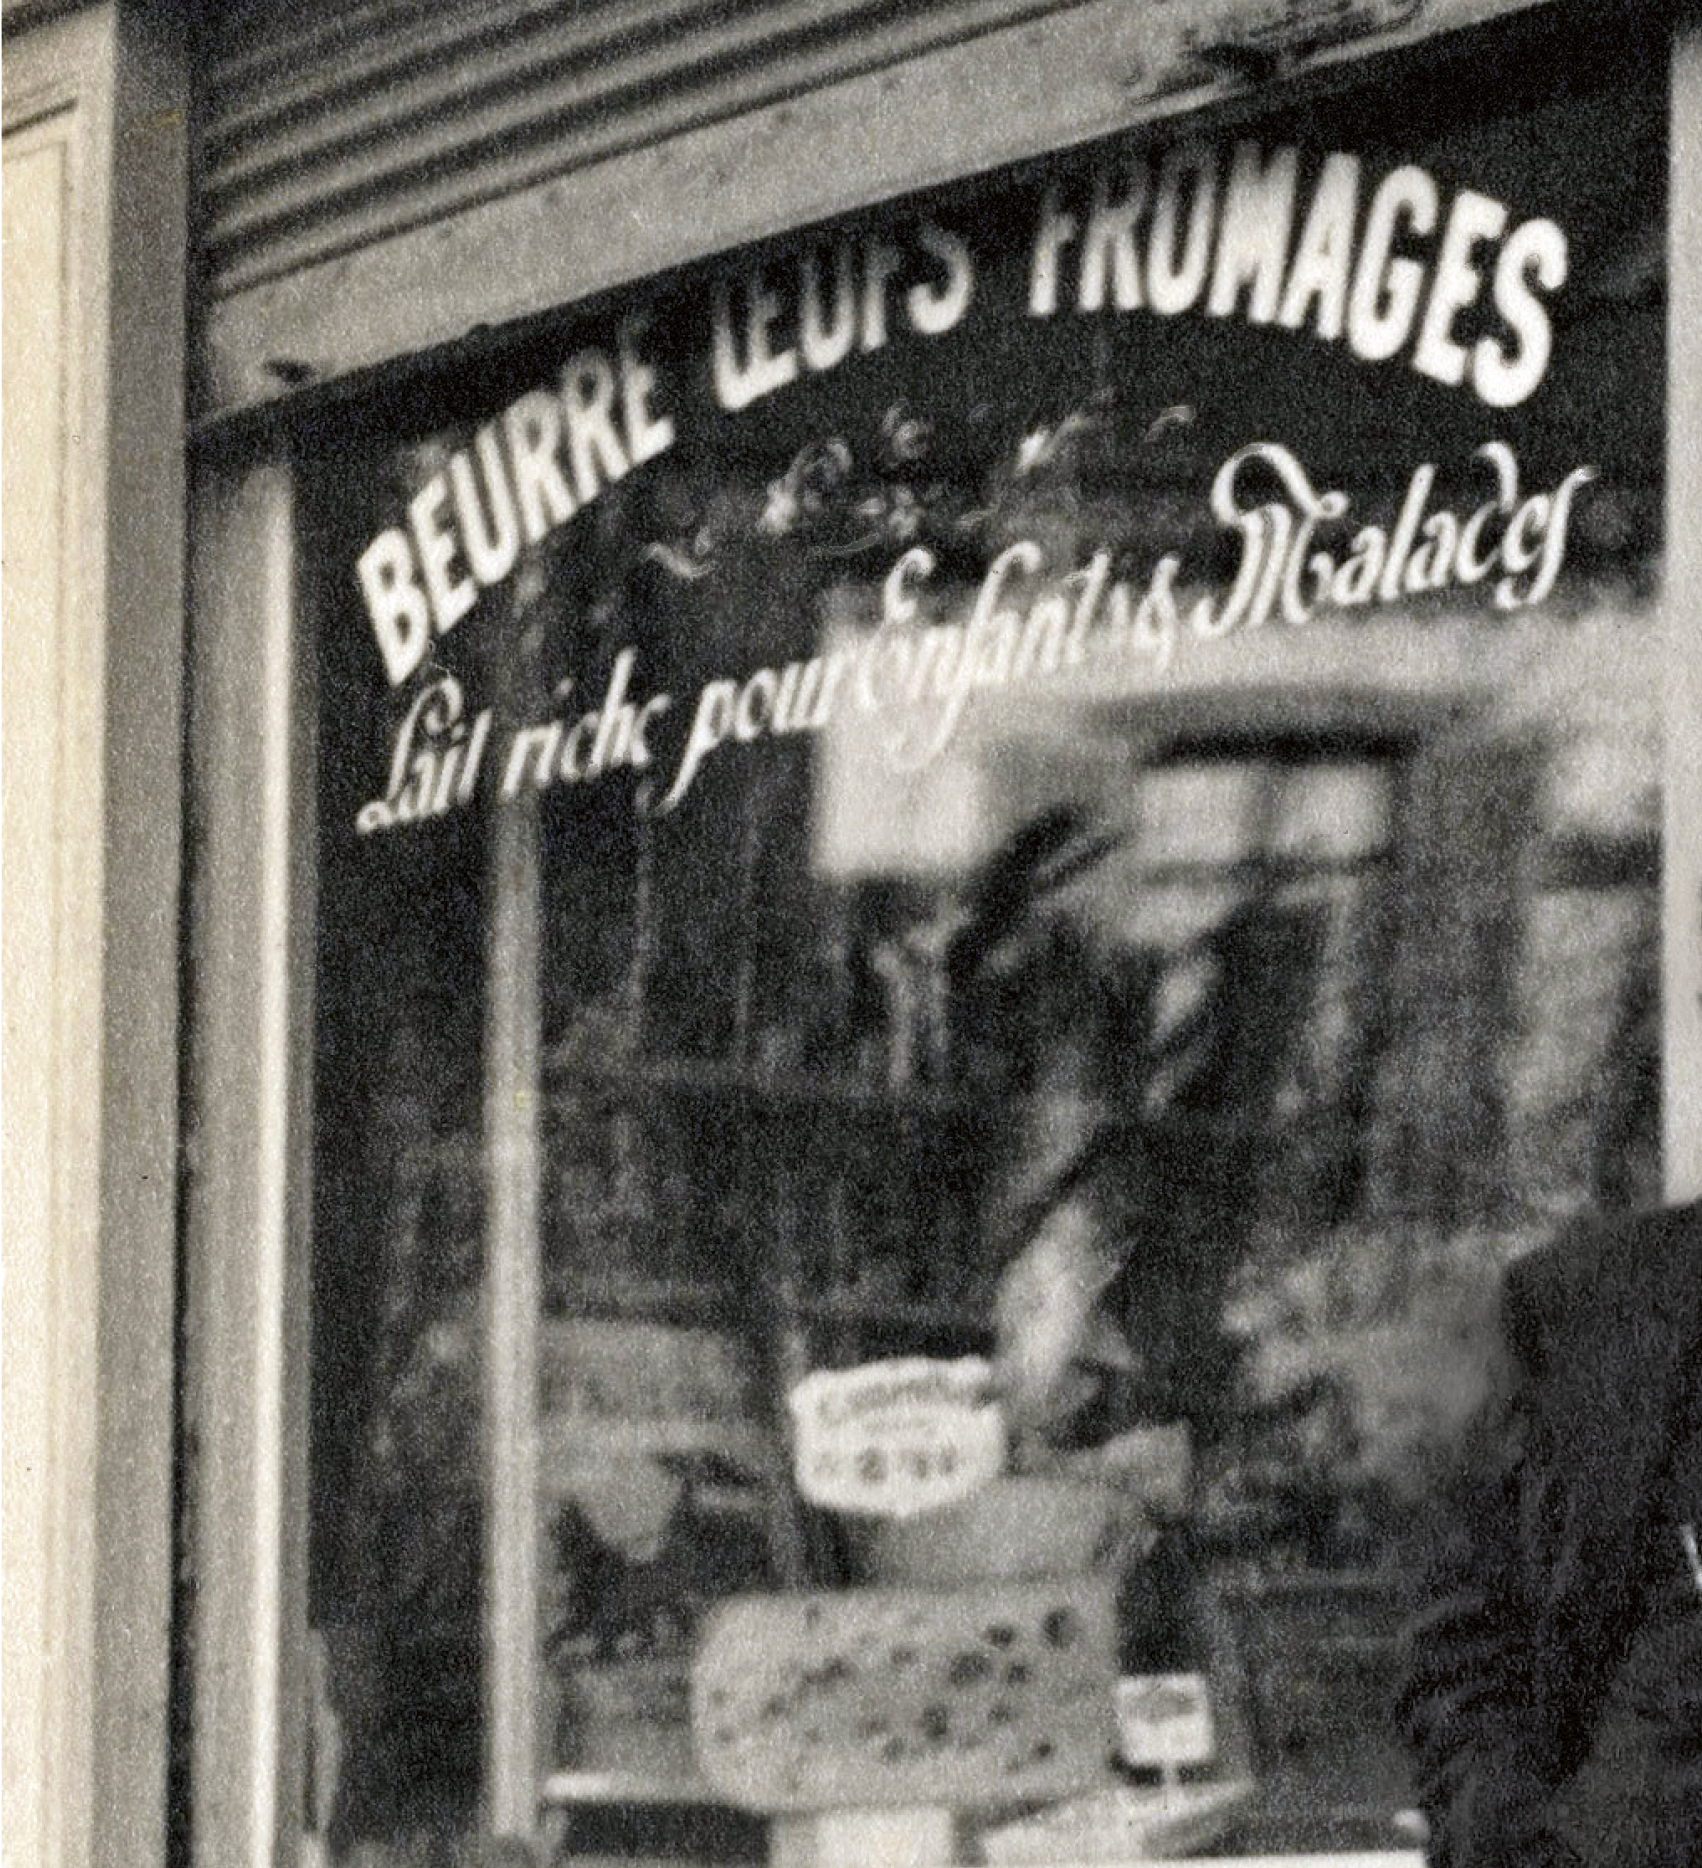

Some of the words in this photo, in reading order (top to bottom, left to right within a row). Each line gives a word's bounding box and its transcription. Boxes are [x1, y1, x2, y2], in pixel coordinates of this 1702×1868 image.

[355, 316, 677, 687] BEURRE
[1028, 136, 1571, 409] FROMAGES
[357, 669, 492, 833] Lait
[502, 647, 671, 799] riche
[640, 648, 852, 815] pour
[1190, 441, 1598, 633] Malades
